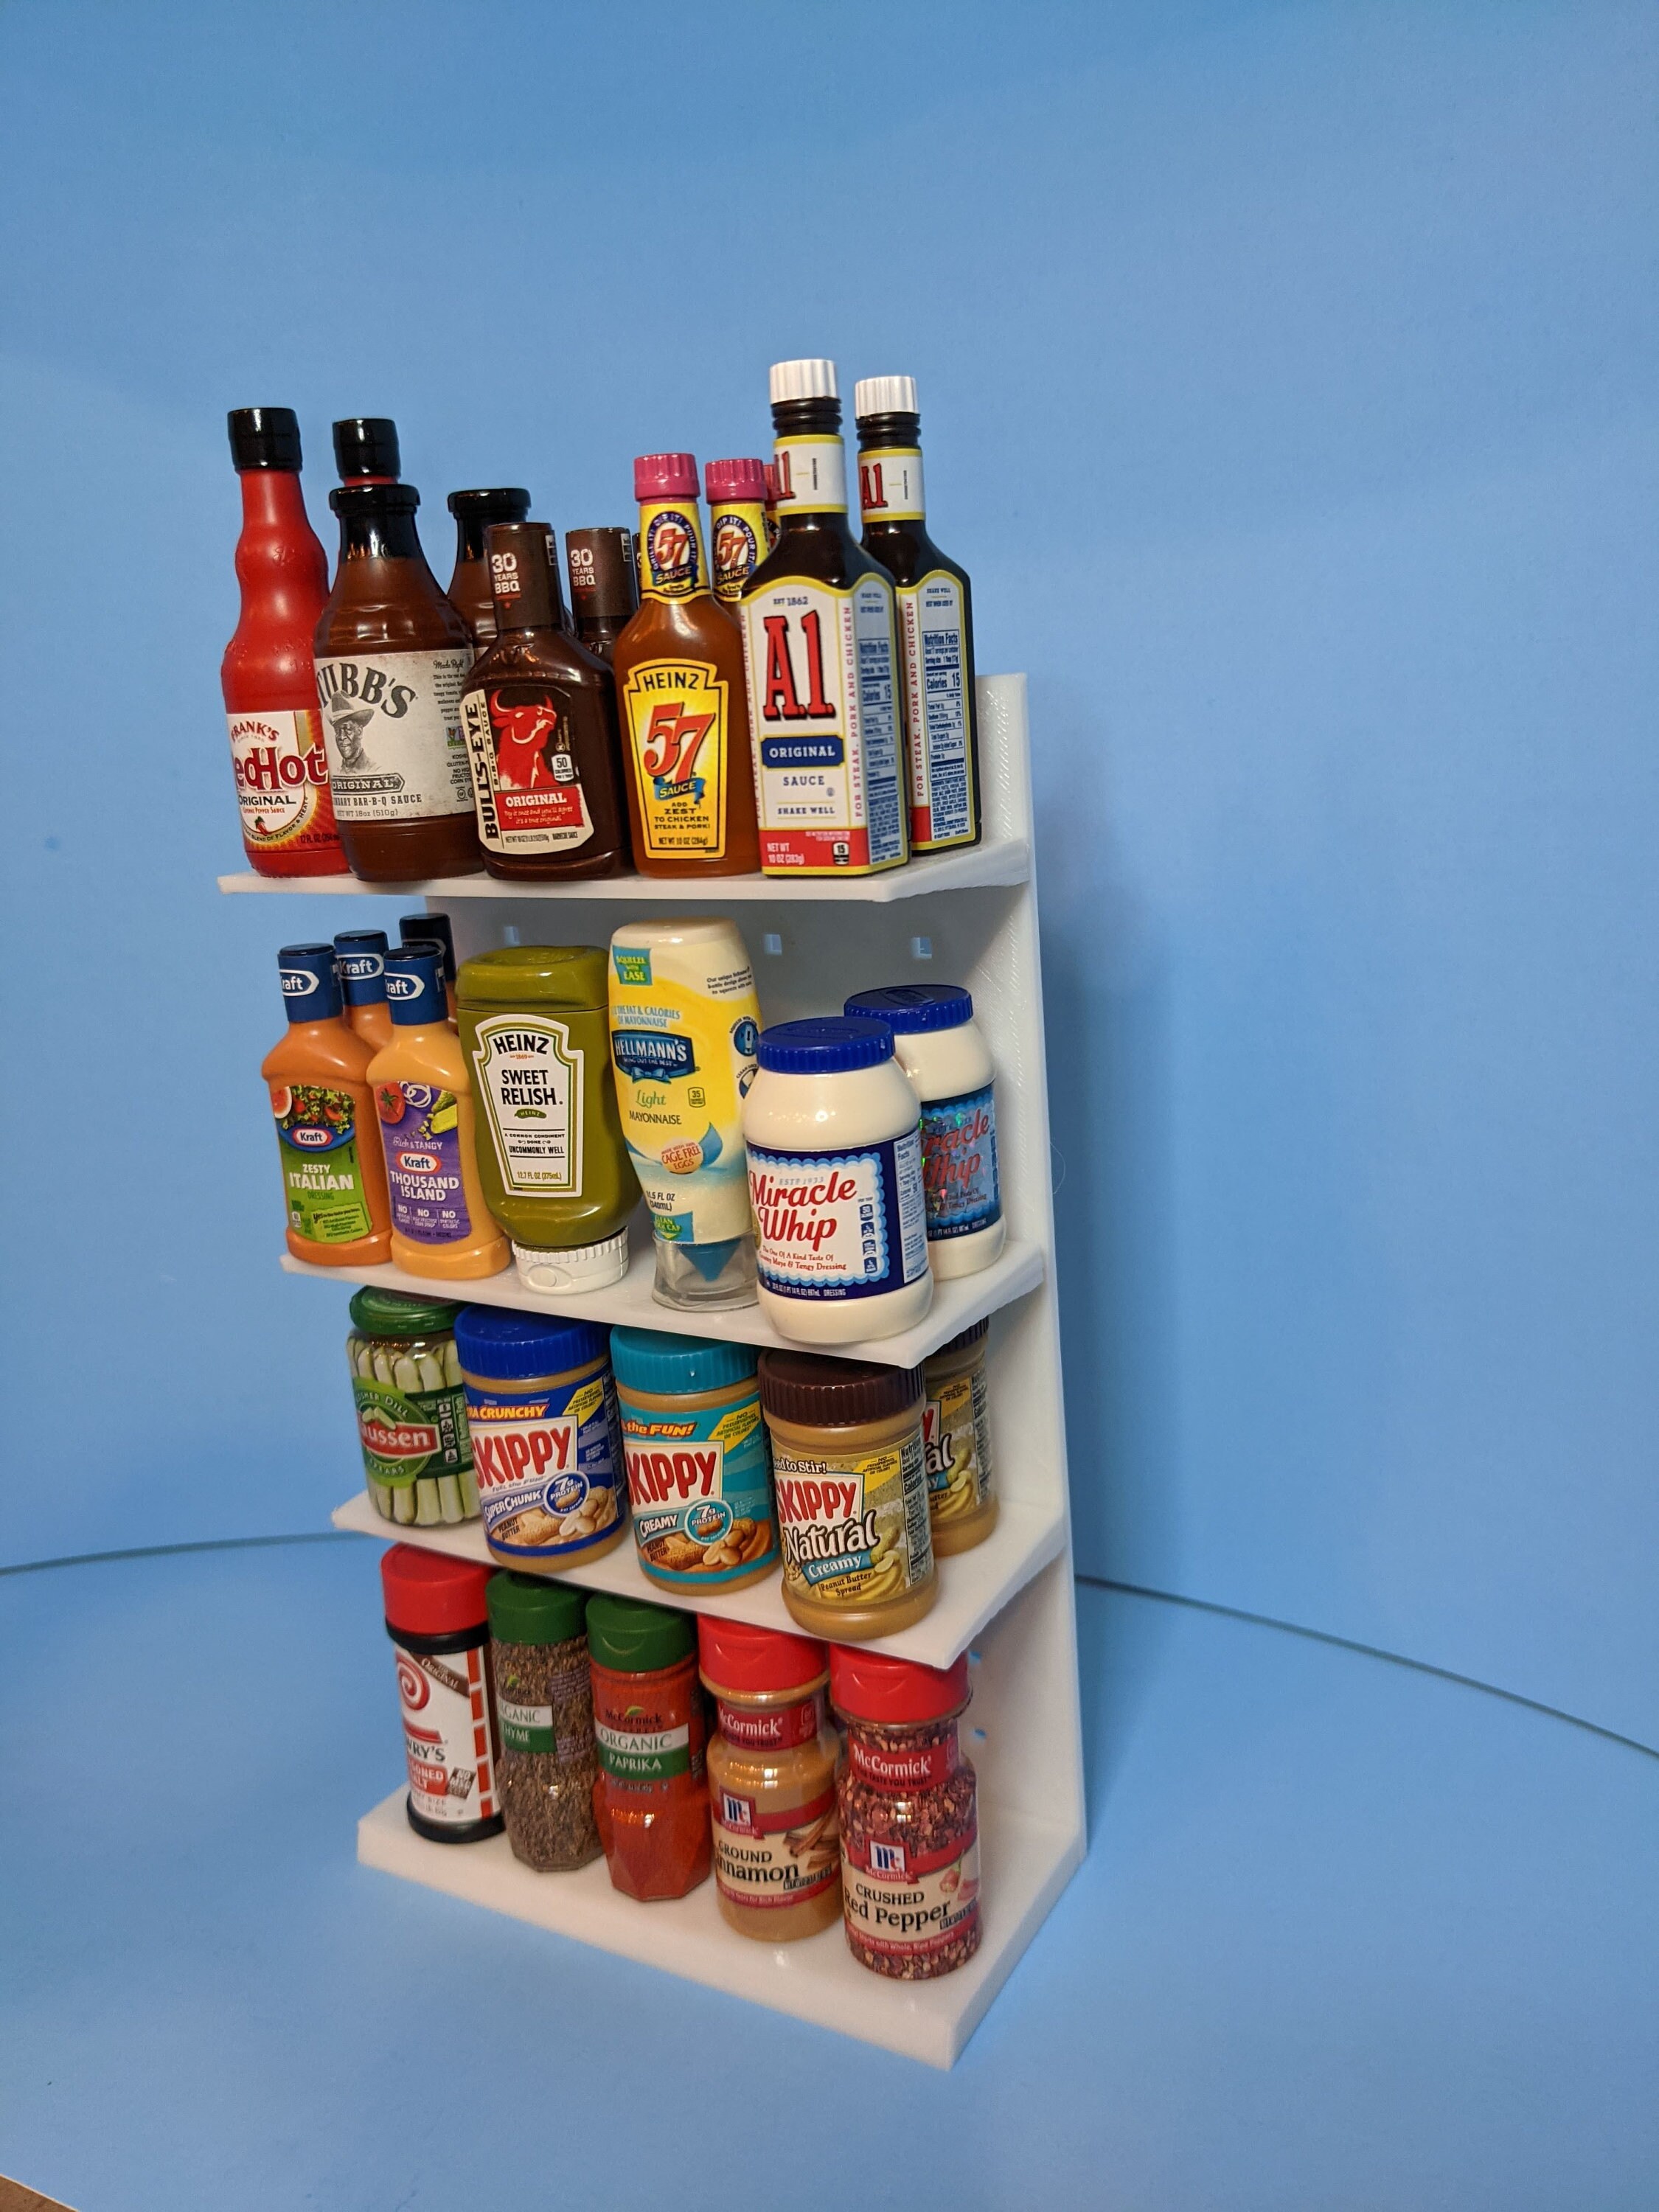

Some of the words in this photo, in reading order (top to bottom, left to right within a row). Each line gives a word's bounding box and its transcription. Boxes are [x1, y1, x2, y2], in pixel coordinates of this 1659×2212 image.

[491, 552, 518, 573] 30
[571, 549, 593, 567] 30
[494, 572, 518, 581] YEARS
[572, 567, 594, 575] YEARS
[655, 566, 692, 584] SAUCE
[717, 566, 750, 585] SAUCE
[495, 580, 520, 594] BBQ
[573, 574, 596, 587] BBQ
[844, 607, 854, 666] CHICKEN
[906, 602, 916, 656] CHICKEN
[945, 633, 958, 644] Facts
[909, 662, 918, 686] AND
[952, 672, 961, 687] 15
[643, 672, 700, 692] HEINZ
[927, 678, 947, 689] Calories
[317, 662, 416, 719] TUBB'S
[911, 692, 919, 723] PORK
[231, 720, 280, 742] FRANK'S
[644, 702, 716, 784] 57
[769, 746, 835, 759] ORIGINAL
[234, 743, 329, 791] edHot
[557, 757, 568, 768] 50
[333, 779, 394, 790] ORIGINAL
[659, 779, 697, 799] SAUCE
[783, 776, 825, 787] SAUCE
[238, 796, 296, 806] ORIGINAL
[354, 795, 387, 807] BAR-B-Q
[392, 793, 422, 804] SAUCE
[506, 793, 567, 807] ORIGINAL
[658, 838, 667, 846] NET
[767, 843, 779, 852] NET
[340, 959, 372, 974] Kraft
[623, 971, 646, 981] EASE
[644, 1007, 681, 1020] CALORIES
[493, 1034, 549, 1055] HEINZ
[614, 1035, 688, 1062] HELLMANN'S
[501, 1069, 549, 1085] SWEET
[501, 1087, 557, 1106] RELISH
[636, 1089, 667, 1109] Light
[629, 1110, 682, 1125] MAYONNAISE
[300, 1132, 323, 1142] Kraft
[925, 1109, 989, 1158] racle
[414, 1141, 442, 1150] TANGY
[509, 1146, 546, 1155] UNCOMMONLY
[548, 1146, 564, 1155] WELL
[404, 1155, 431, 1169] Kraft
[662, 1151, 681, 1164] CAGE
[683, 1146, 701, 1158] FREE
[302, 1164, 330, 1174] ZESTY
[674, 1158, 695, 1170] EGGS
[289, 1172, 354, 1191] ITALIAN
[390, 1170, 459, 1190] THOUSAND
[527, 1171, 534, 1180] FL
[535, 1172, 540, 1180] OZ
[401, 1185, 446, 1202] ISLAND
[657, 1192, 664, 1200] FL
[666, 1193, 675, 1201] OZ
[749, 1171, 858, 1207] Miracle
[398, 1205, 408, 1214] NO
[417, 1208, 430, 1217] NO
[442, 1211, 456, 1219] NO
[758, 1206, 837, 1251] Whip
[795, 1262, 814, 1270] Tangy
[816, 1262, 846, 1271] Dressing
[584, 1388, 594, 1397] NO
[480, 1405, 546, 1418] CRUNCHY
[737, 1411, 748, 1420] NO
[363, 1424, 429, 1447] ussen
[627, 1421, 648, 1433] the
[649, 1422, 696, 1436] FUN!
[786, 1461, 797, 1472] to
[799, 1461, 827, 1474] Stir!
[550, 1481, 583, 1500] PROTEIN
[554, 1476, 574, 1491] 7g
[692, 1512, 726, 1526] PROTEIN
[697, 1505, 716, 1518] 7g
[498, 1518, 518, 1534] PEANUT
[501, 1526, 521, 1541] BUTTER
[639, 1514, 677, 1538] CREAMY
[785, 1511, 880, 1563] Natural
[650, 1547, 667, 1562] BUTTER
[808, 1555, 862, 1578] Creamy
[821, 1578, 846, 1591] Peanut
[846, 1571, 872, 1583] Butter
[836, 1583, 861, 1597] Spread
[422, 1658, 459, 1690] ORIGINAL
[605, 1708, 662, 1725] McCormick
[601, 1728, 672, 1751] ORGANIC
[609, 1752, 662, 1772] PAPRIKA
[854, 1745, 931, 1777] McCormick
[457, 1770, 470, 1779] NO
[889, 1778, 905, 1787] YOU
[719, 1840, 773, 1863] GROUND
[866, 1864, 912, 1881] McCormick
[856, 1882, 925, 1906] CRUSHED
[875, 1900, 951, 1933] Pepper
